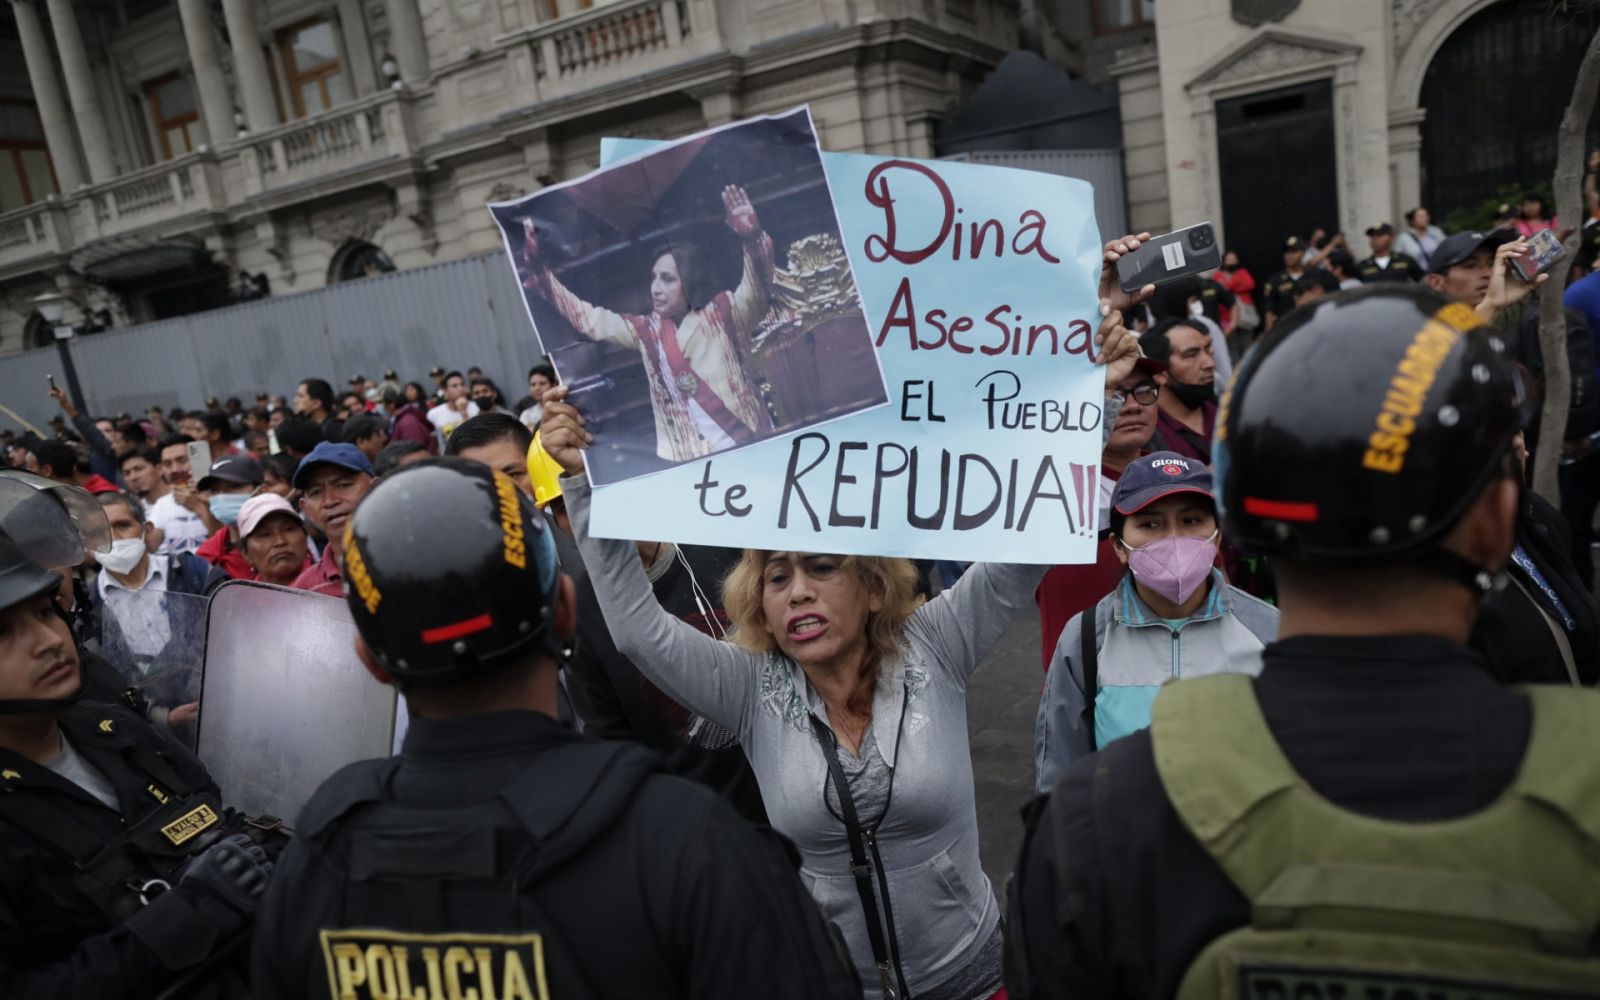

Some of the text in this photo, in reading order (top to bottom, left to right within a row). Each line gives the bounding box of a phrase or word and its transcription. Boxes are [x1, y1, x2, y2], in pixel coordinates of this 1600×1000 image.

[864, 159, 1060, 264] Dina
[901, 370, 1101, 433] EL PUEBLO
[694, 459, 753, 517] te
[1151, 459, 1190, 471] GLORIA
[332, 943, 540, 1000] POLICIA
